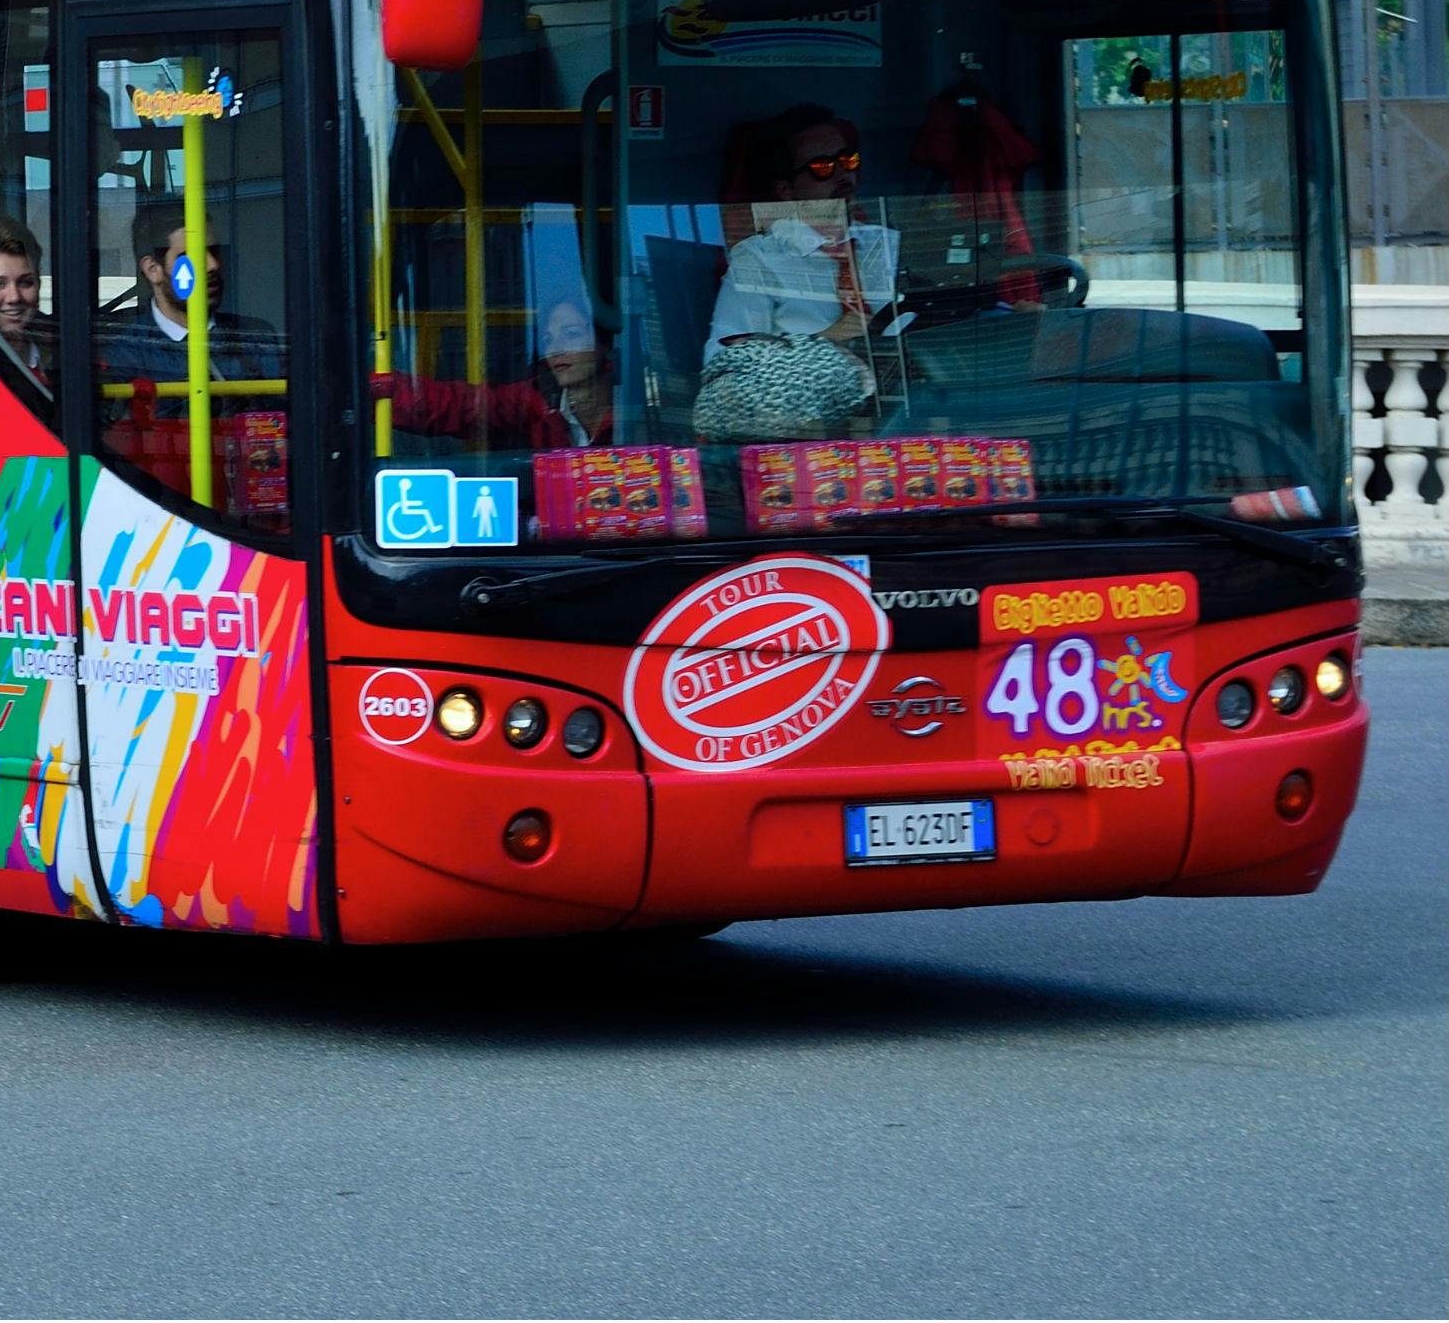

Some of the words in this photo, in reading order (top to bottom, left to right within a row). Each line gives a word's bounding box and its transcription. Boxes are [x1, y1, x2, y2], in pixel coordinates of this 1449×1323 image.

[700, 571, 785, 616] TOUR
[872, 588, 980, 609] VOLVO
[993, 590, 1104, 634] Biglietto
[1108, 581, 1187, 619] Valido
[88, 587, 257, 655] VIAGGI
[671, 617, 840, 703] OFFICIAL
[364, 696, 427, 718] 2603
[987, 638, 1099, 735] 48
[695, 736, 734, 762] OF
[739, 677, 856, 759] GENOVA
[1005, 757, 1077, 791] Valid
[1078, 754, 1164, 789] Ticket
[869, 815, 896, 847] EL
[902, 812, 972, 846] 623DF
